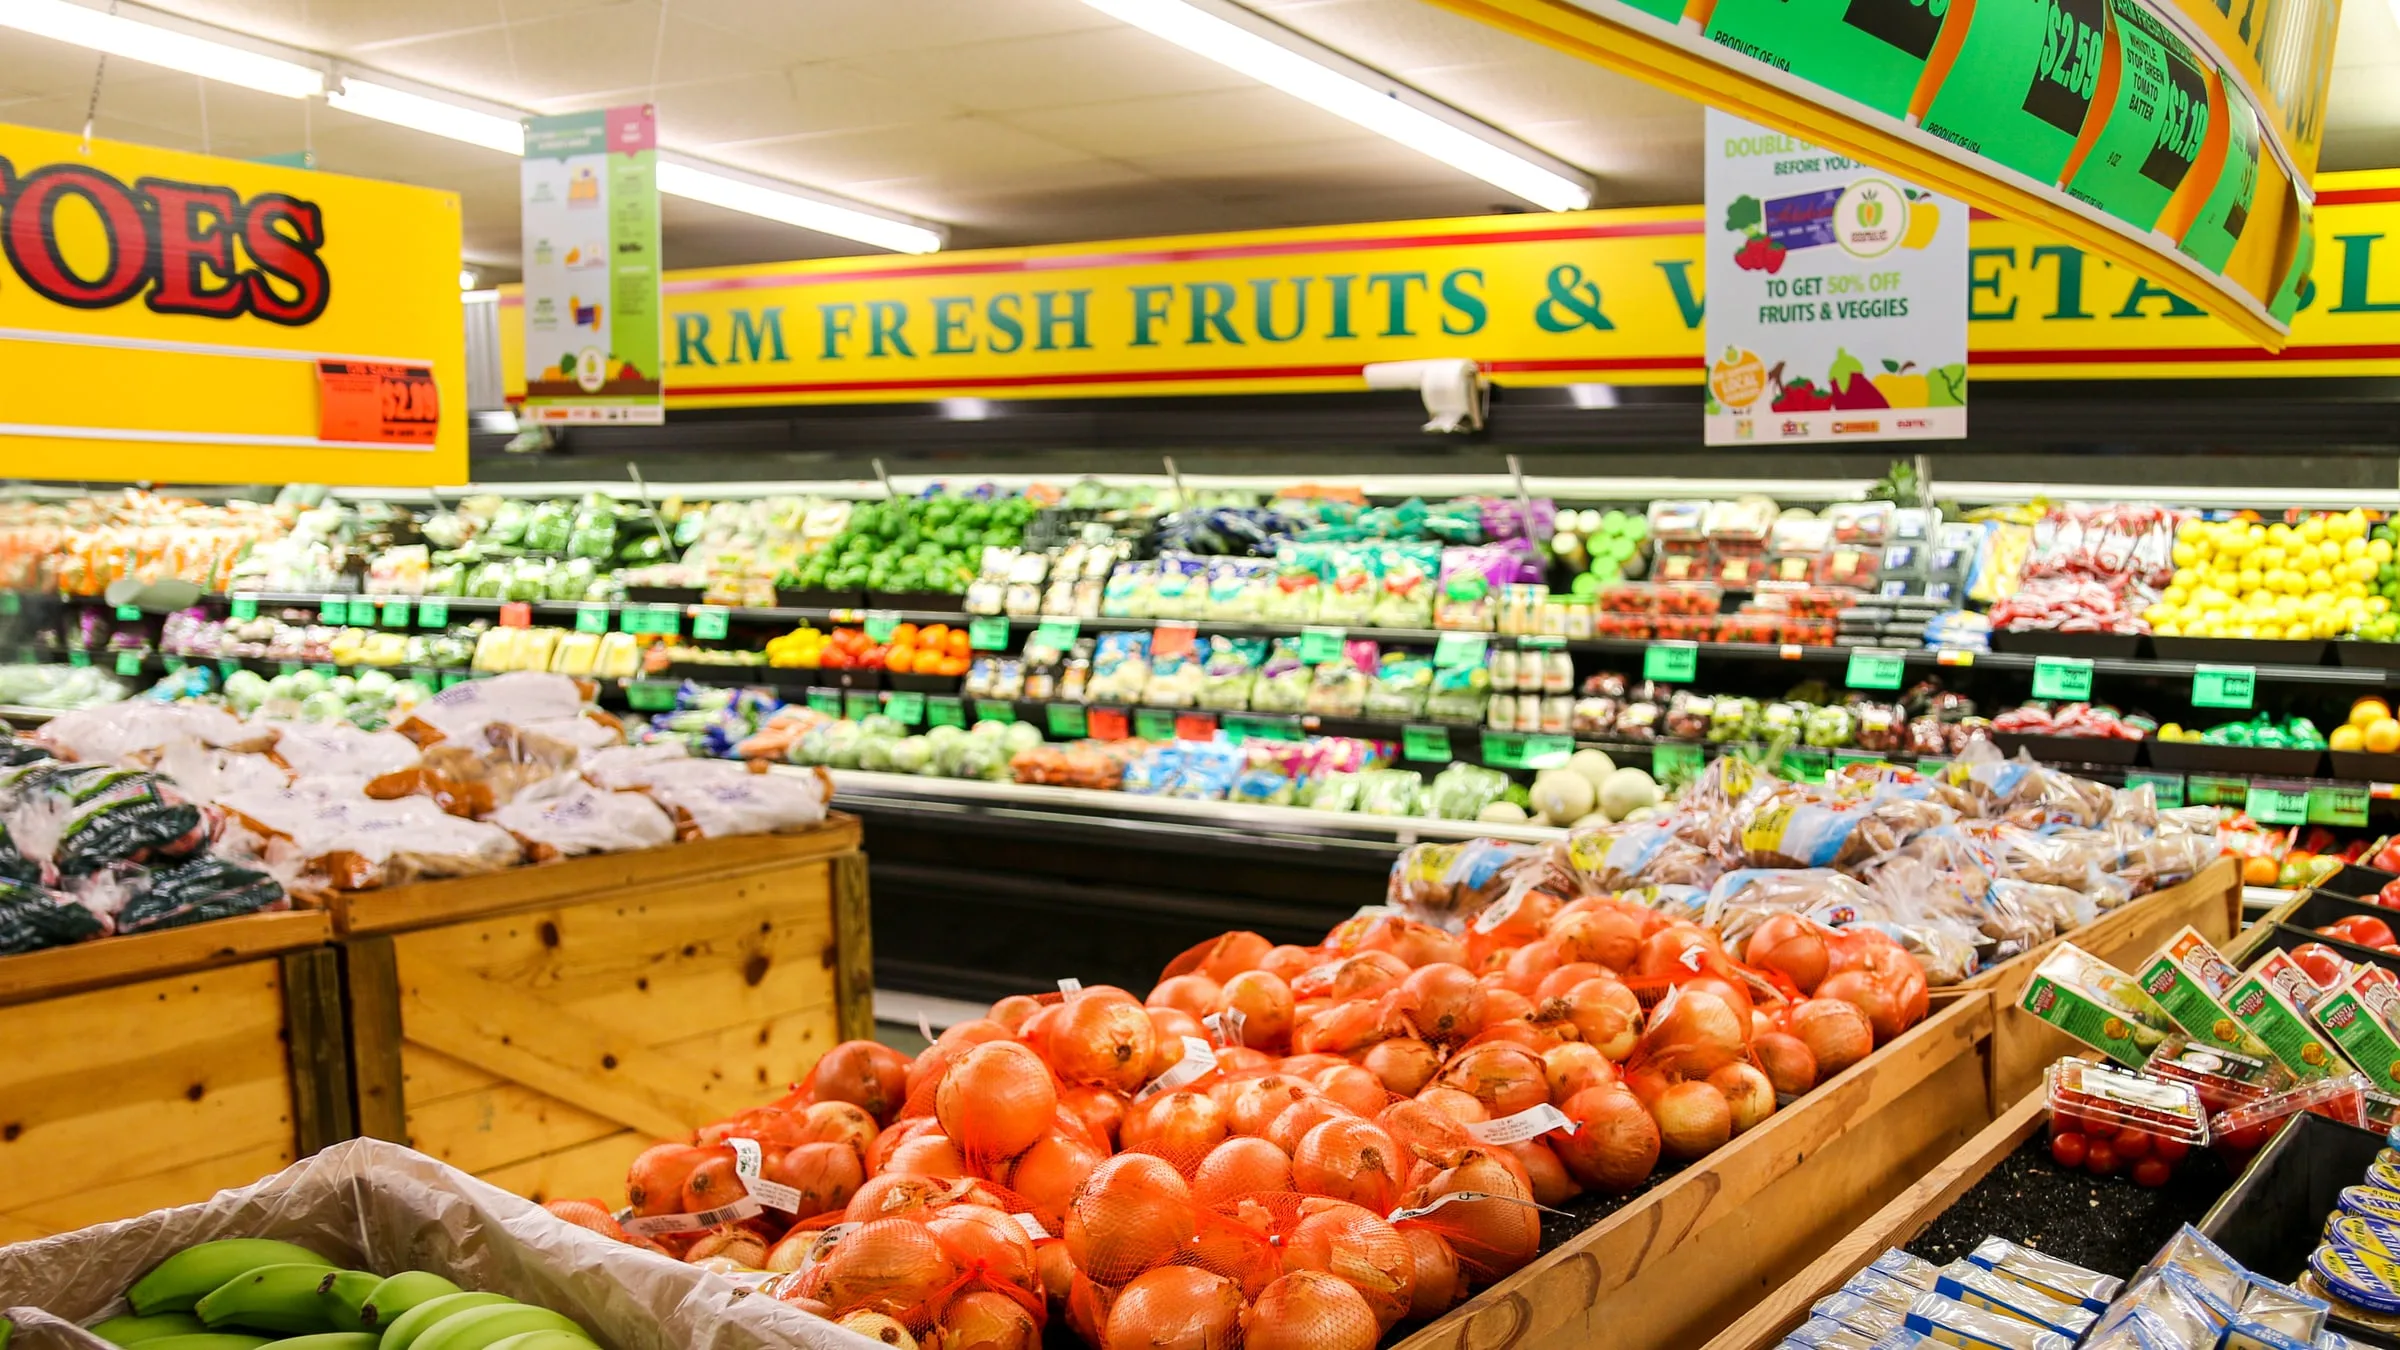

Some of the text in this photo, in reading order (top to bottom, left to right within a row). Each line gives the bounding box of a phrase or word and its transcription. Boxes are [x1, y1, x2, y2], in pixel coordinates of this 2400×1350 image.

[2040, 0, 2101, 100] $2.59
[2128, 31, 2157, 62] WHISTLE
[2127, 48, 2165, 86] STOP GREEN
[2134, 72, 2158, 101] TOMATO
[2128, 93, 2154, 122] BATTER
[2158, 79, 2208, 162] $3.19
[1725, 134, 1794, 158] DOUBLE
[1774, 158, 1821, 176] BEFORE
[1824, 156, 1850, 171] YOU
[0, 157, 330, 326] OES
[1766, 271, 1901, 298] TO GET 50% OFF
[662, 306, 793, 367] RM
[816, 287, 1094, 361] FRESH
[1127, 268, 1489, 348] FRUITS
[1534, 263, 1617, 334] &
[1759, 298, 1908, 324] FRUITS & VEGGIES
